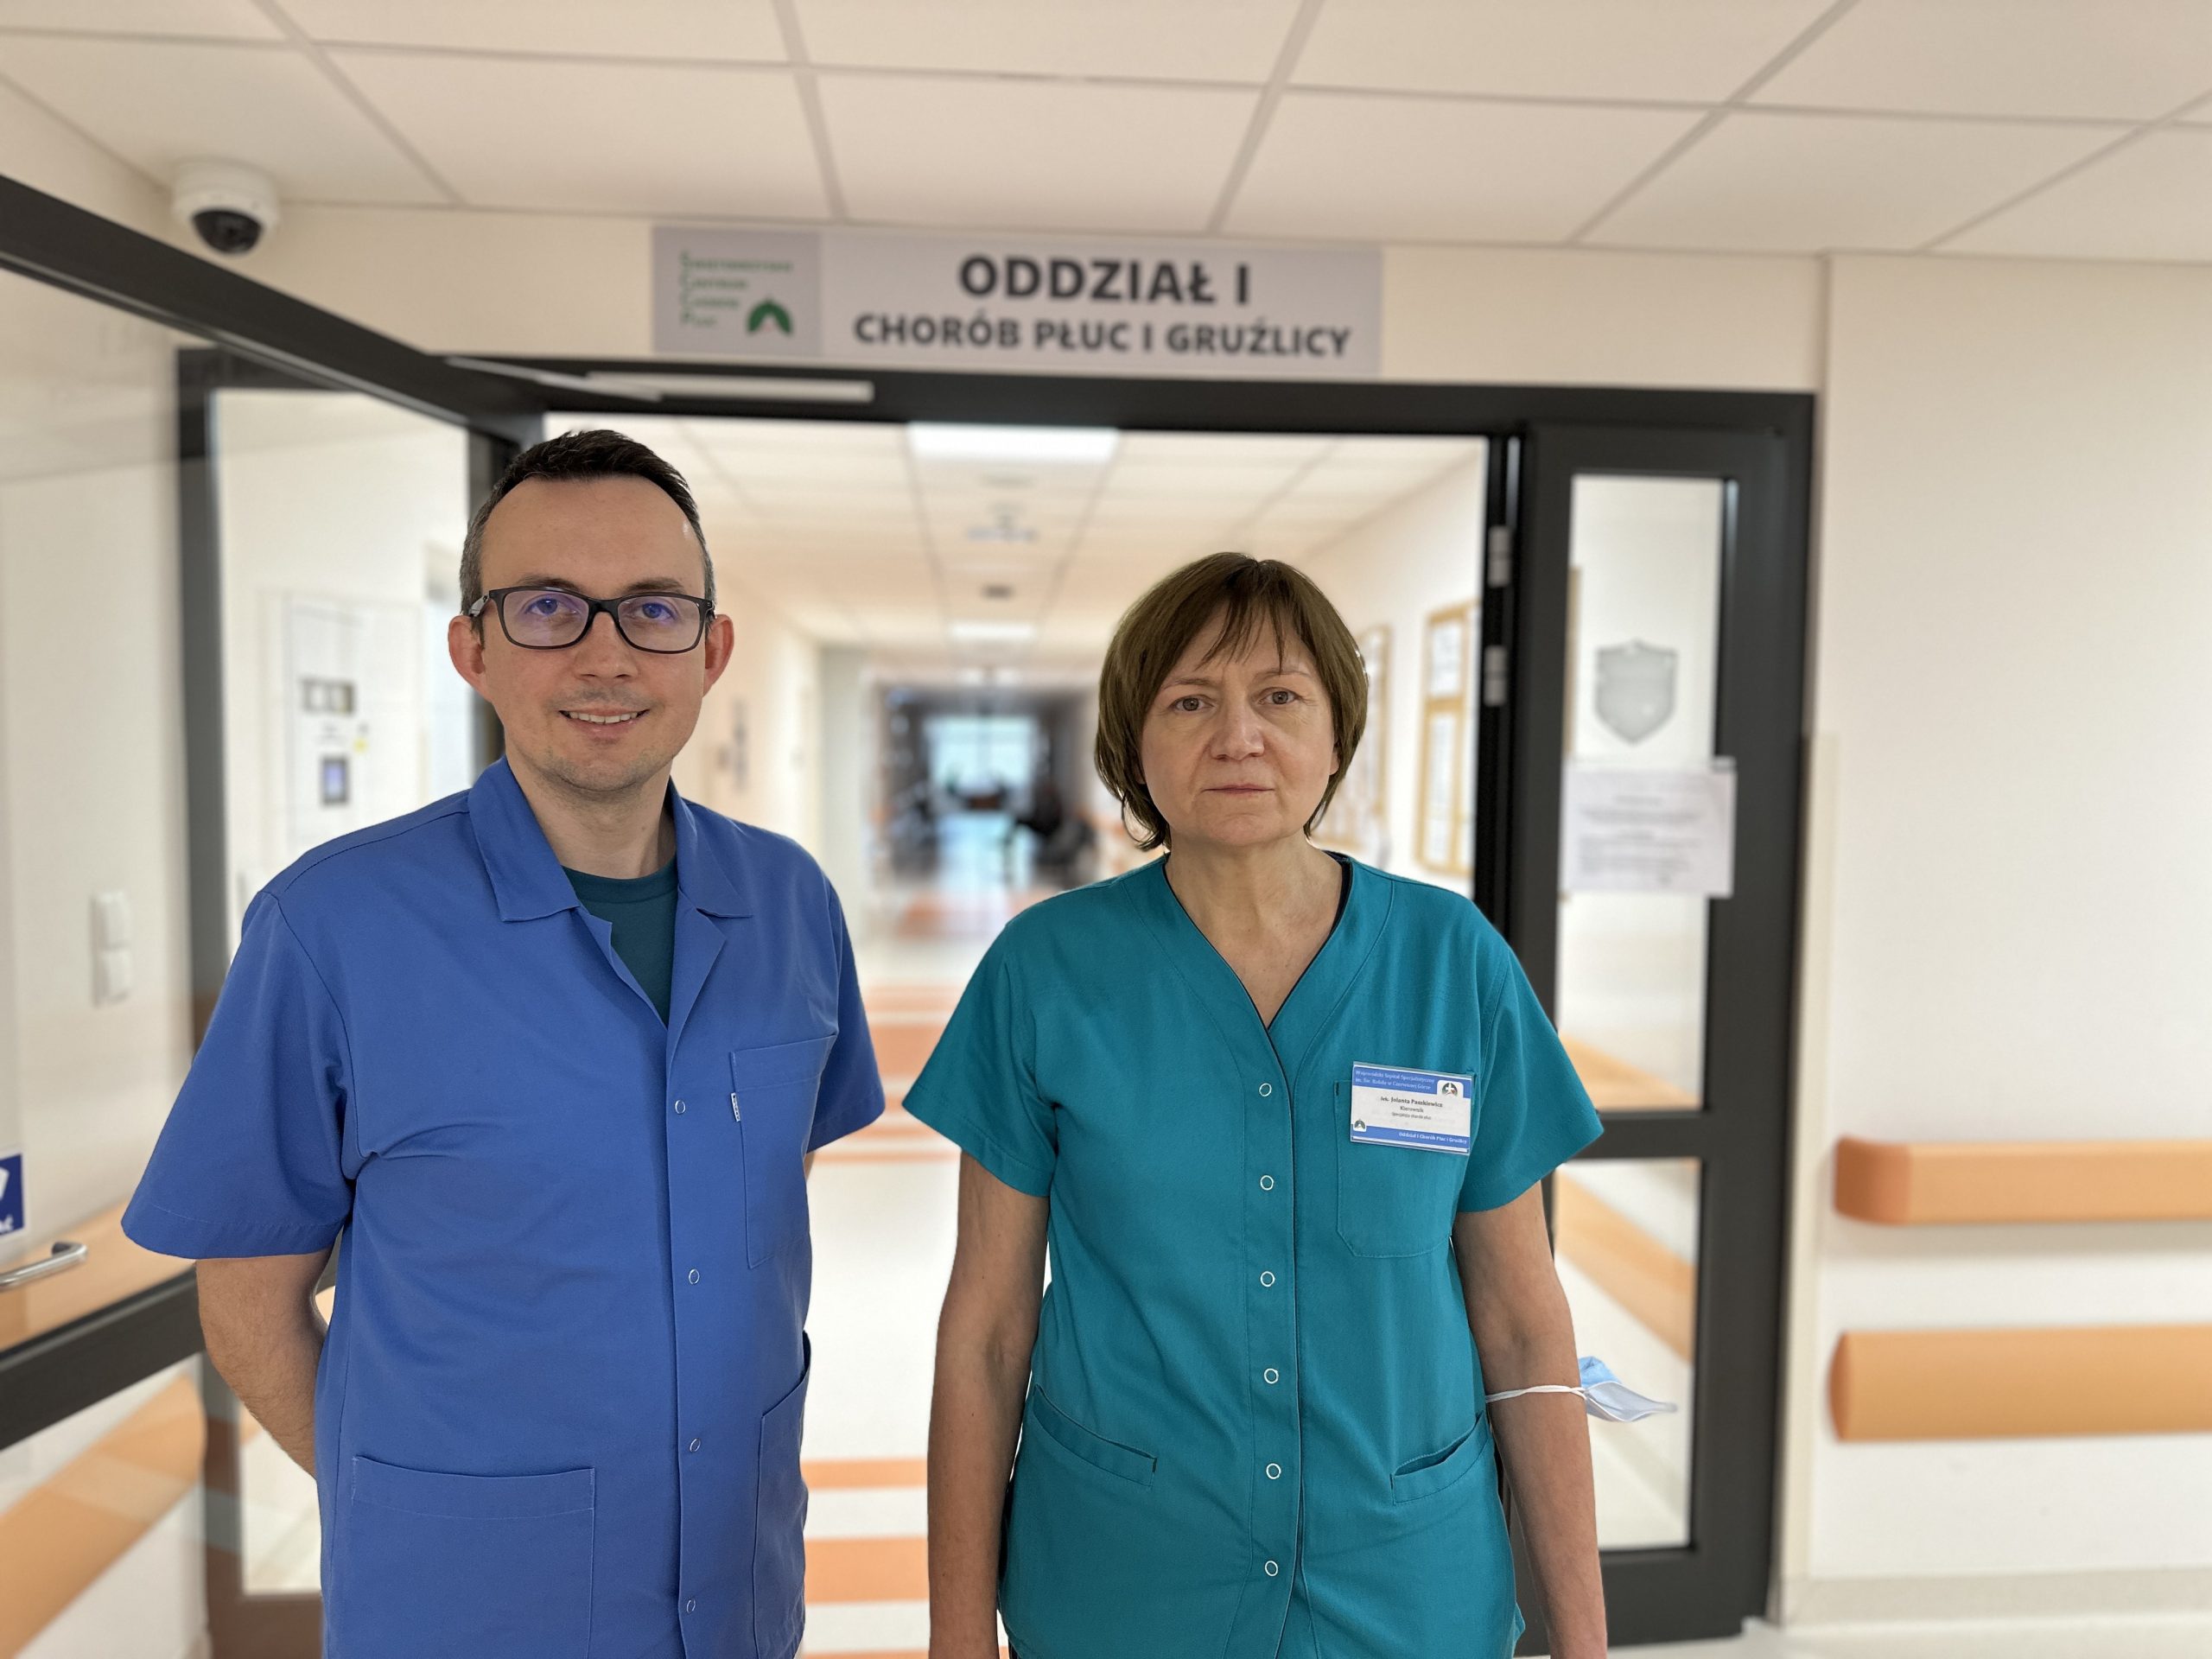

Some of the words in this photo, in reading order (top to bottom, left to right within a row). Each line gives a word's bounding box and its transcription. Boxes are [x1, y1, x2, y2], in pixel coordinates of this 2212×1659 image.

[958, 255, 1215, 304] ODDZIAŁ
[1236, 263, 1249, 305] I
[854, 307, 1020, 347] CHORÓB
[1034, 320, 1131, 352] PŁUC
[1142, 321, 1153, 353] I
[1166, 315, 1351, 358] GRUŹLICY
